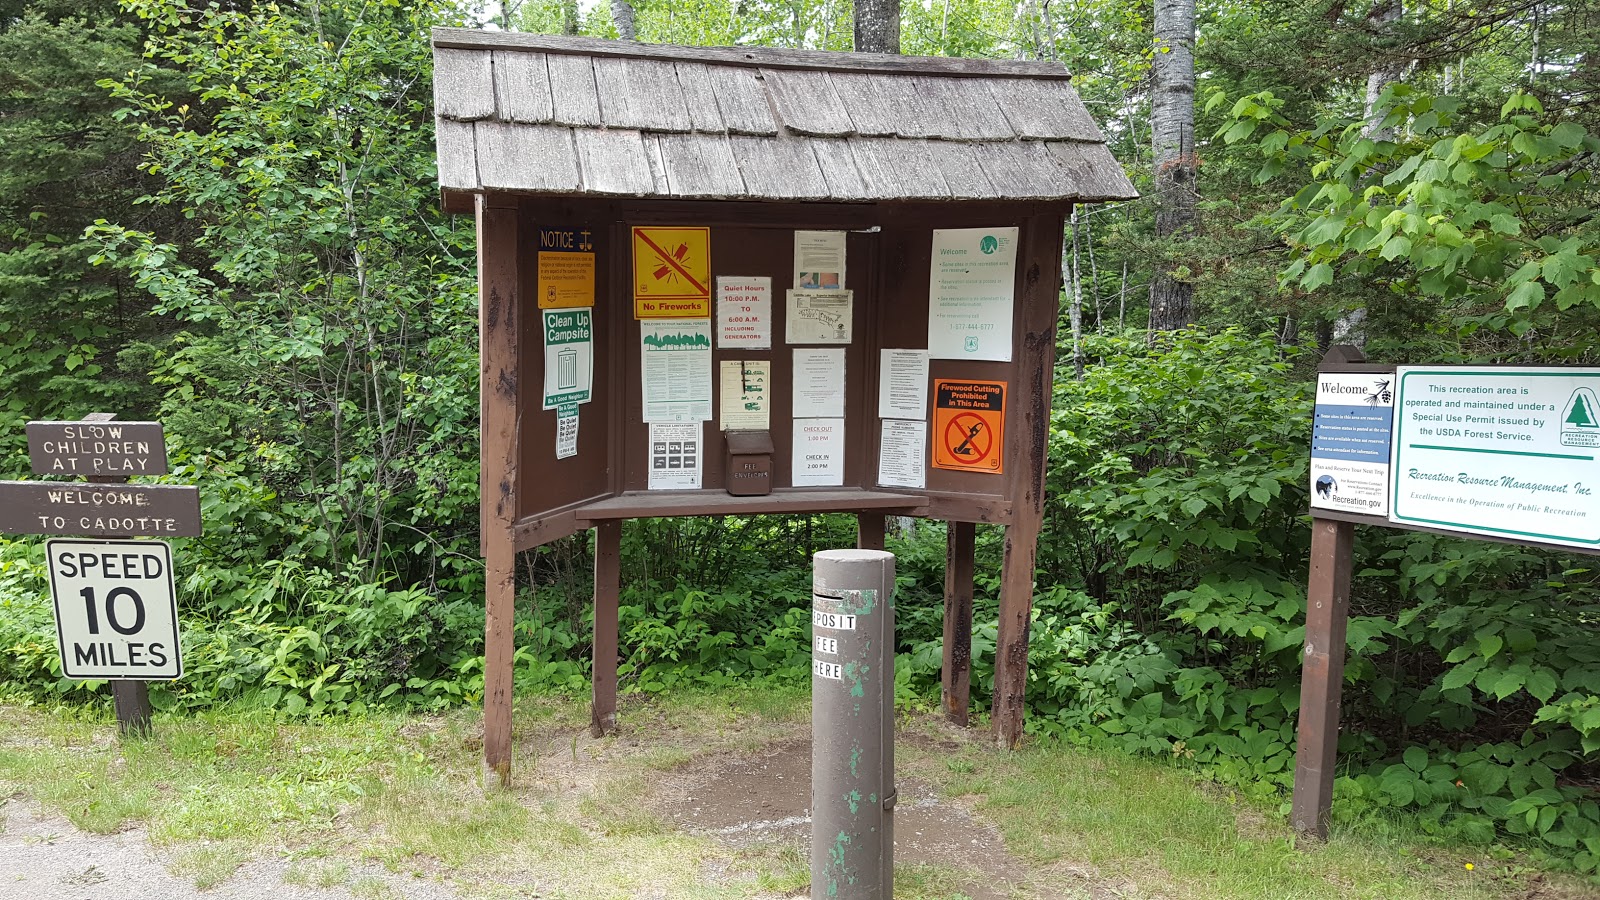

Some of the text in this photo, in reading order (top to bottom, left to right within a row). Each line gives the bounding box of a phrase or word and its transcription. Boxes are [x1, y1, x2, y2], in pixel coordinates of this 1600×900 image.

[541, 230, 573, 248] NOTICE
[659, 302, 701, 310] Fireworks
[548, 313, 588, 328] Clean Up
[548, 328, 589, 342] Campsite
[973, 385, 1000, 394] Cutting
[1322, 383, 1368, 394] Welcome
[1429, 385, 1446, 393] This
[1450, 385, 1493, 394] recreation
[1521, 387, 1528, 395] is
[952, 392, 987, 400] Prohibited
[1406, 400, 1442, 408] operated
[1445, 400, 1460, 408] and
[1464, 401, 1513, 410] maintained
[1518, 403, 1546, 411] under
[1412, 412, 1544, 428] Special Use Permit issued by
[65, 427, 122, 439] SLOW
[1420, 427, 1534, 441] the USDA Forest Service.
[44, 441, 149, 454] CHILDREN
[53, 458, 148, 471] AT PLAY
[1408, 468, 1454, 482] Recreation
[1456, 473, 1498, 486] Resource
[48, 491, 148, 505] WELCOME
[1333, 495, 1381, 508] Recreation.gov
[1410, 492, 1445, 502] Excellence
[1456, 496, 1467, 505] the
[1469, 498, 1504, 509] Operation
[1506, 502, 1515, 511] of
[1517, 503, 1541, 513] Public
[1544, 506, 1587, 518] Recreation
[39, 516, 177, 531] TO CADOTTE
[59, 552, 163, 579] SPEED
[80, 587, 145, 635] 10
[817, 637, 835, 652] FEE
[74, 643, 167, 667] MILES
[815, 662, 839, 678] HERE
